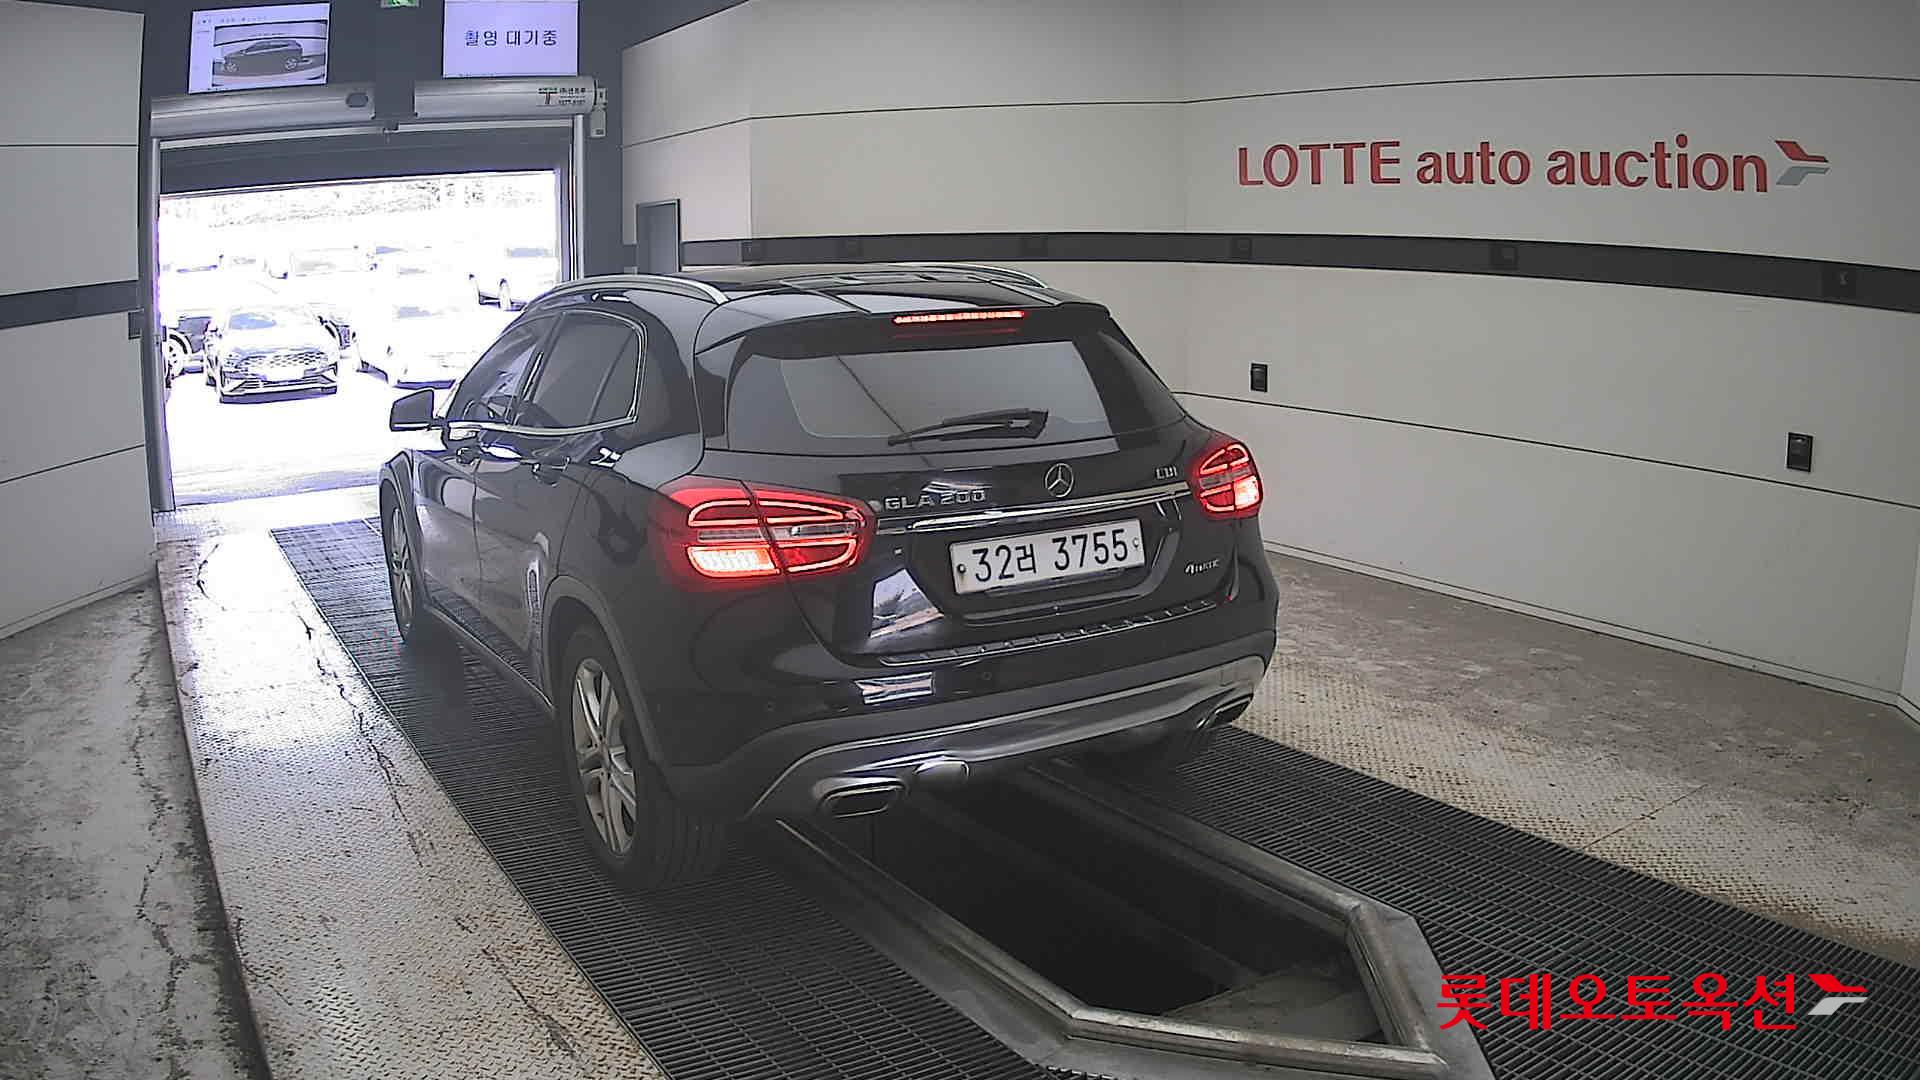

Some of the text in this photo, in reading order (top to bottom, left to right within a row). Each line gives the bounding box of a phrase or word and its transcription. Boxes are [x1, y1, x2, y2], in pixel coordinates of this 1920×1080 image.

[505, 30, 557, 47] 대기중
[1239, 135, 1768, 192] LOTTE auto auction
[885, 489, 986, 510] GLA 200
[972, 528, 1129, 582] 32러 3755
